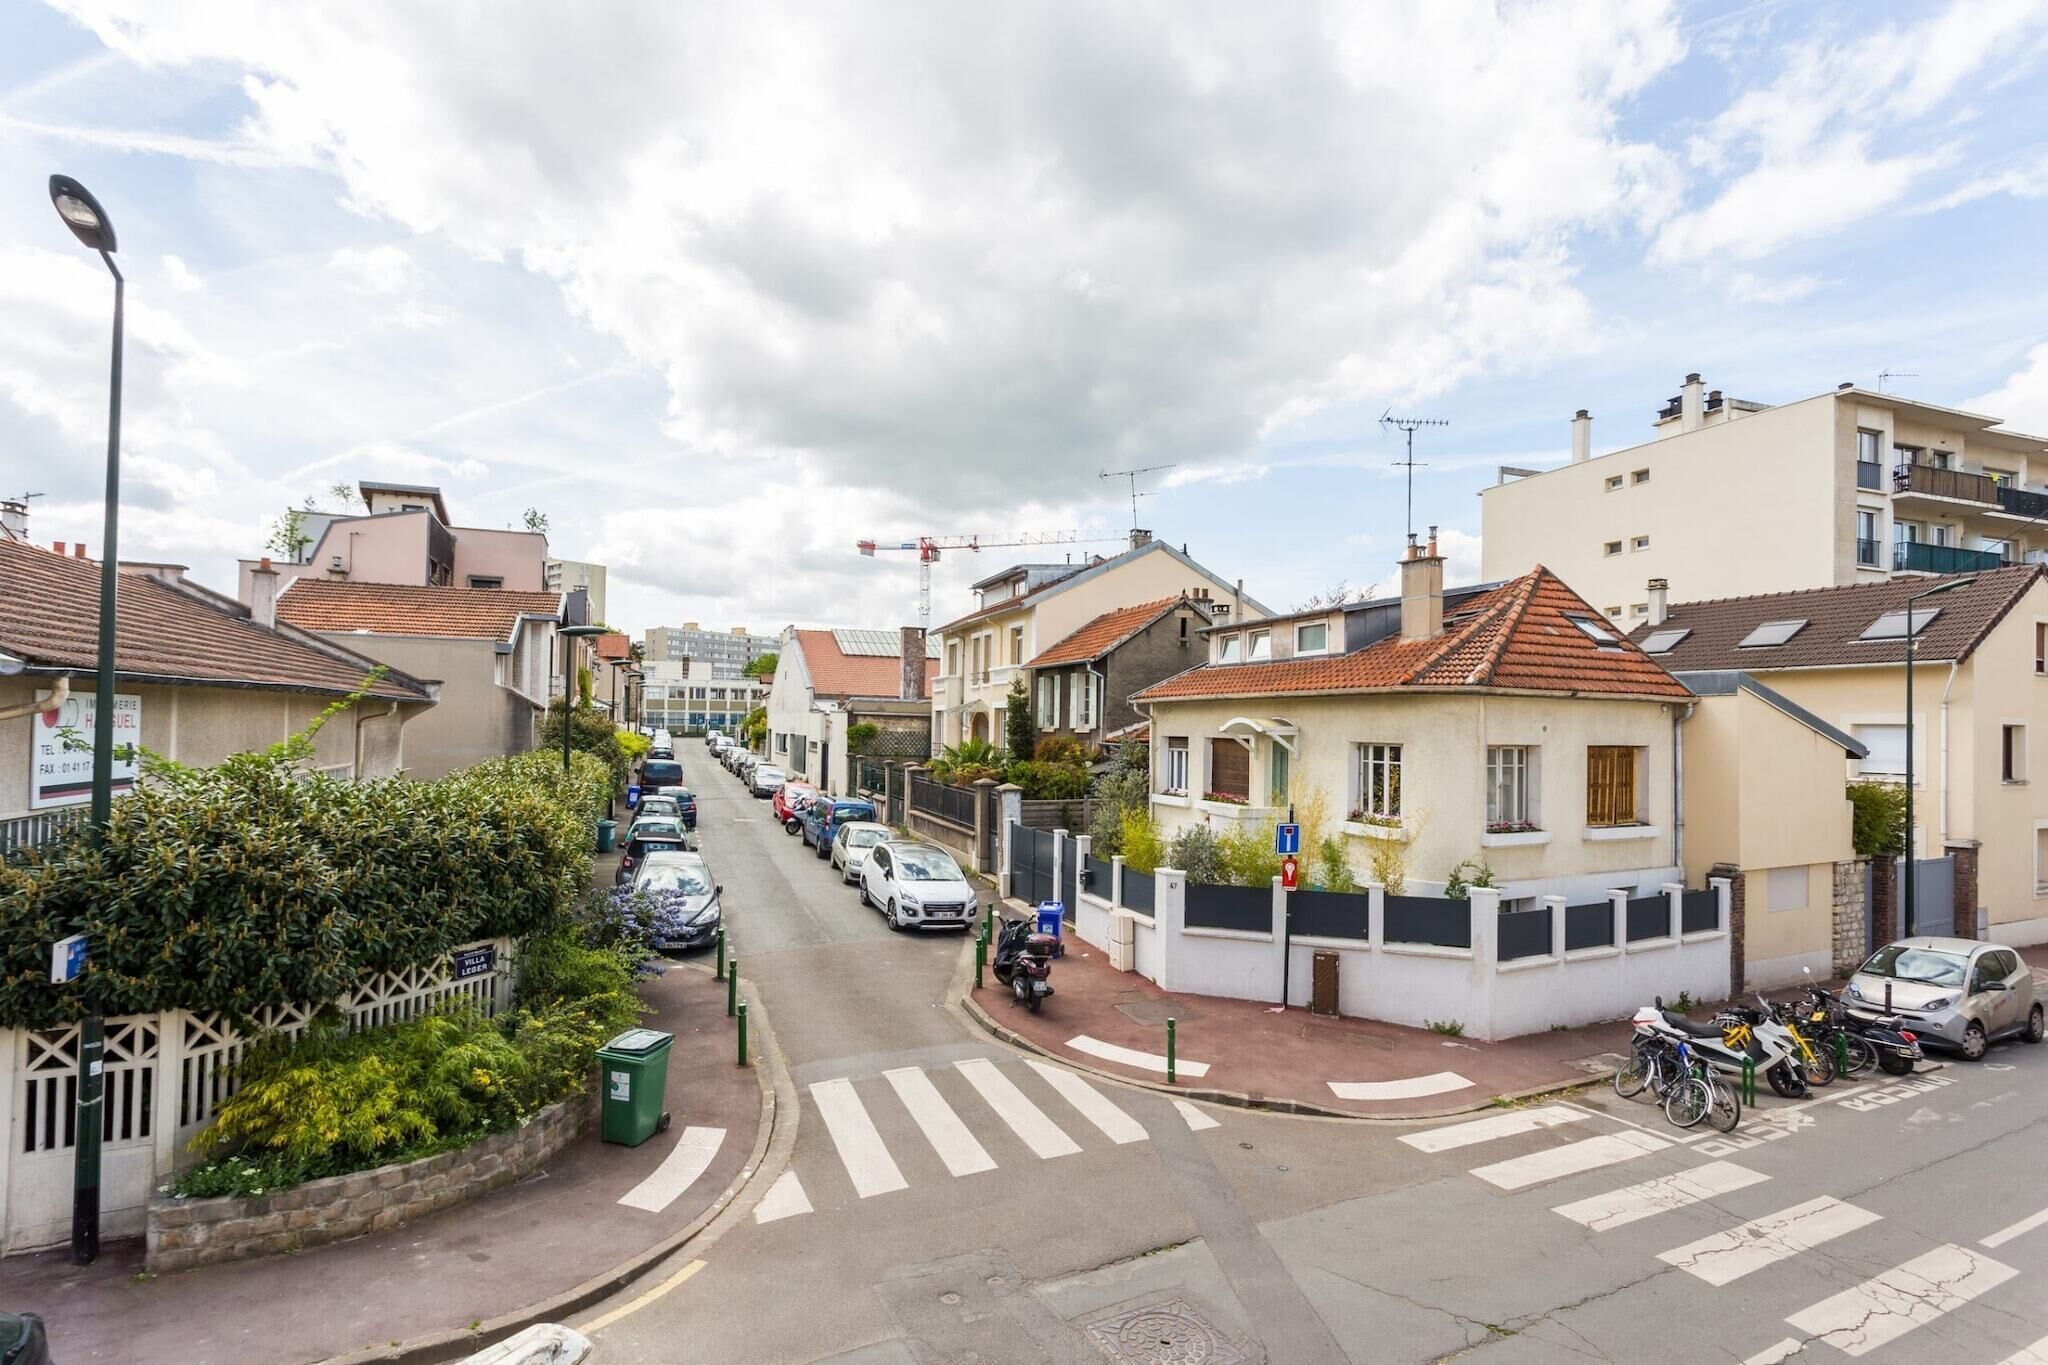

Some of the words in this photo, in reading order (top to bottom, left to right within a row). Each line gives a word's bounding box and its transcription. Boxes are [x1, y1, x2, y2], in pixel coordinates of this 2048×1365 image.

[86, 699, 137, 711] IMMERIE
[40, 744, 55, 756] TEL
[39, 764, 55, 775] FAX
[72, 762, 80, 772] 41
[1168, 882, 1177, 890] 47
[464, 956, 485, 966] VILLA
[462, 964, 487, 976] LEGER
[1837, 1075, 1959, 1112] ROUES
